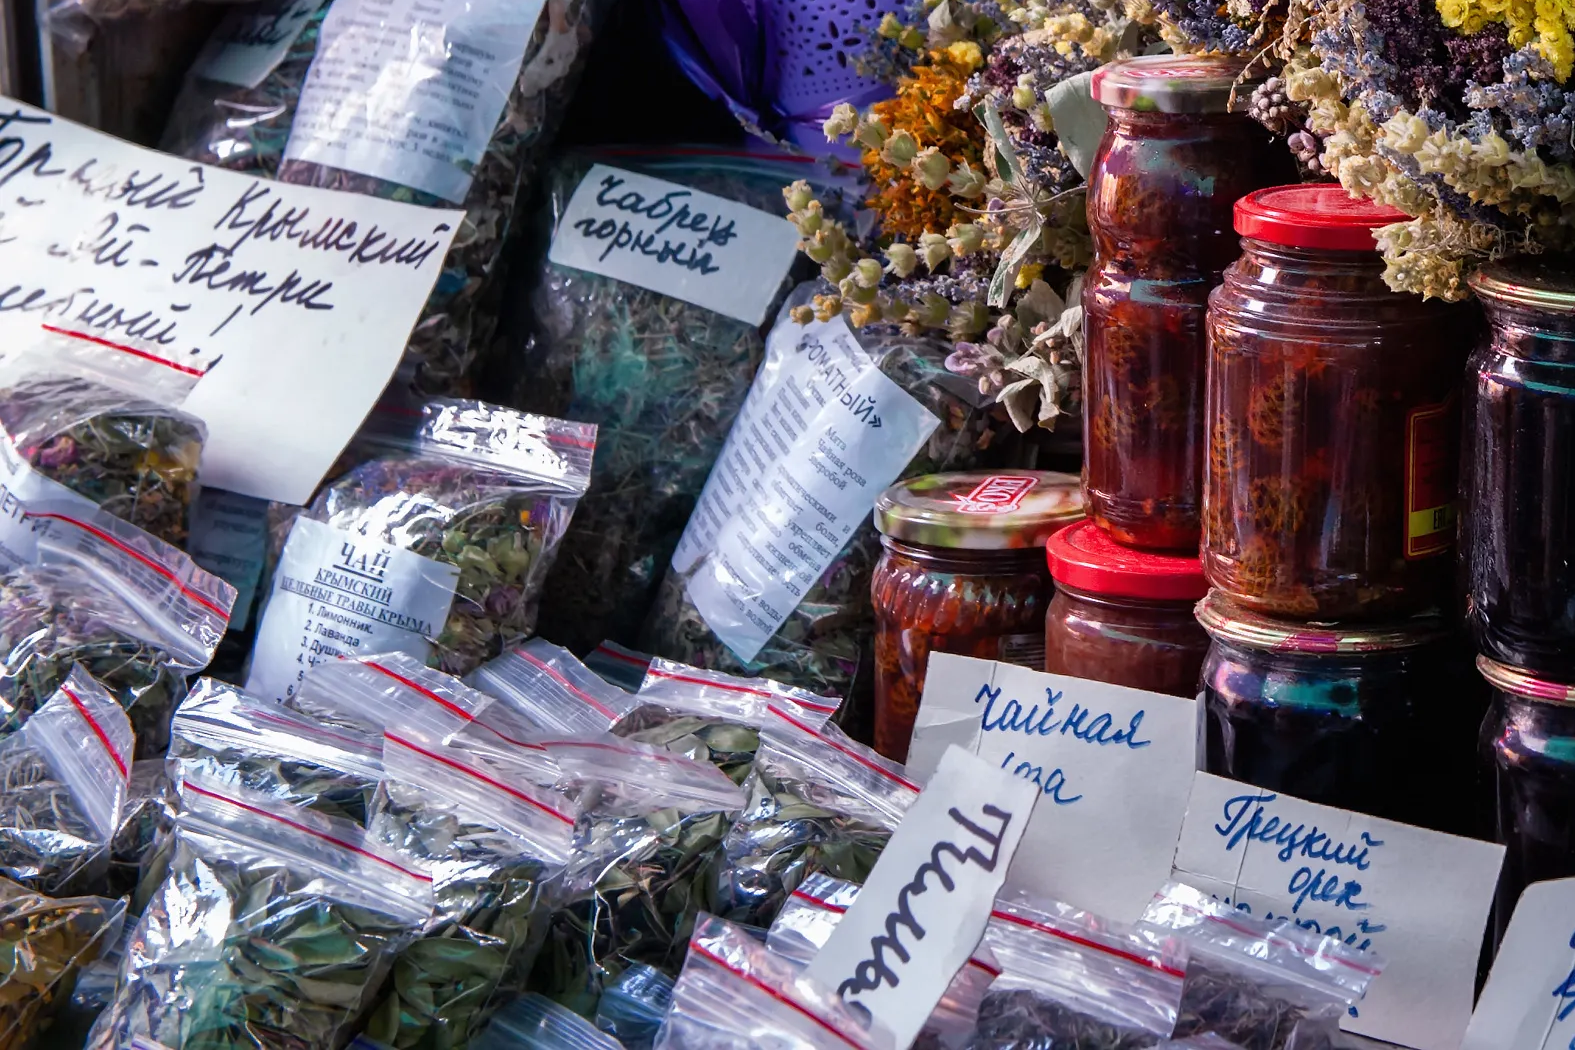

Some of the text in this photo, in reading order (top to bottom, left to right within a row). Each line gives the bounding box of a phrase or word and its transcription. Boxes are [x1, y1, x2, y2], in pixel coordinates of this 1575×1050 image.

[340, 542, 392, 578] ЧАЙ
[315, 568, 393, 603] КРЫМСКИЙ
[335, 593, 376, 617] ТРАВЫ
[378, 610, 432, 634] КРЫМА
[314, 622, 360, 647] Лаванда
[975, 684, 1151, 749] Чайная
[1214, 793, 1385, 871] Грецкий
